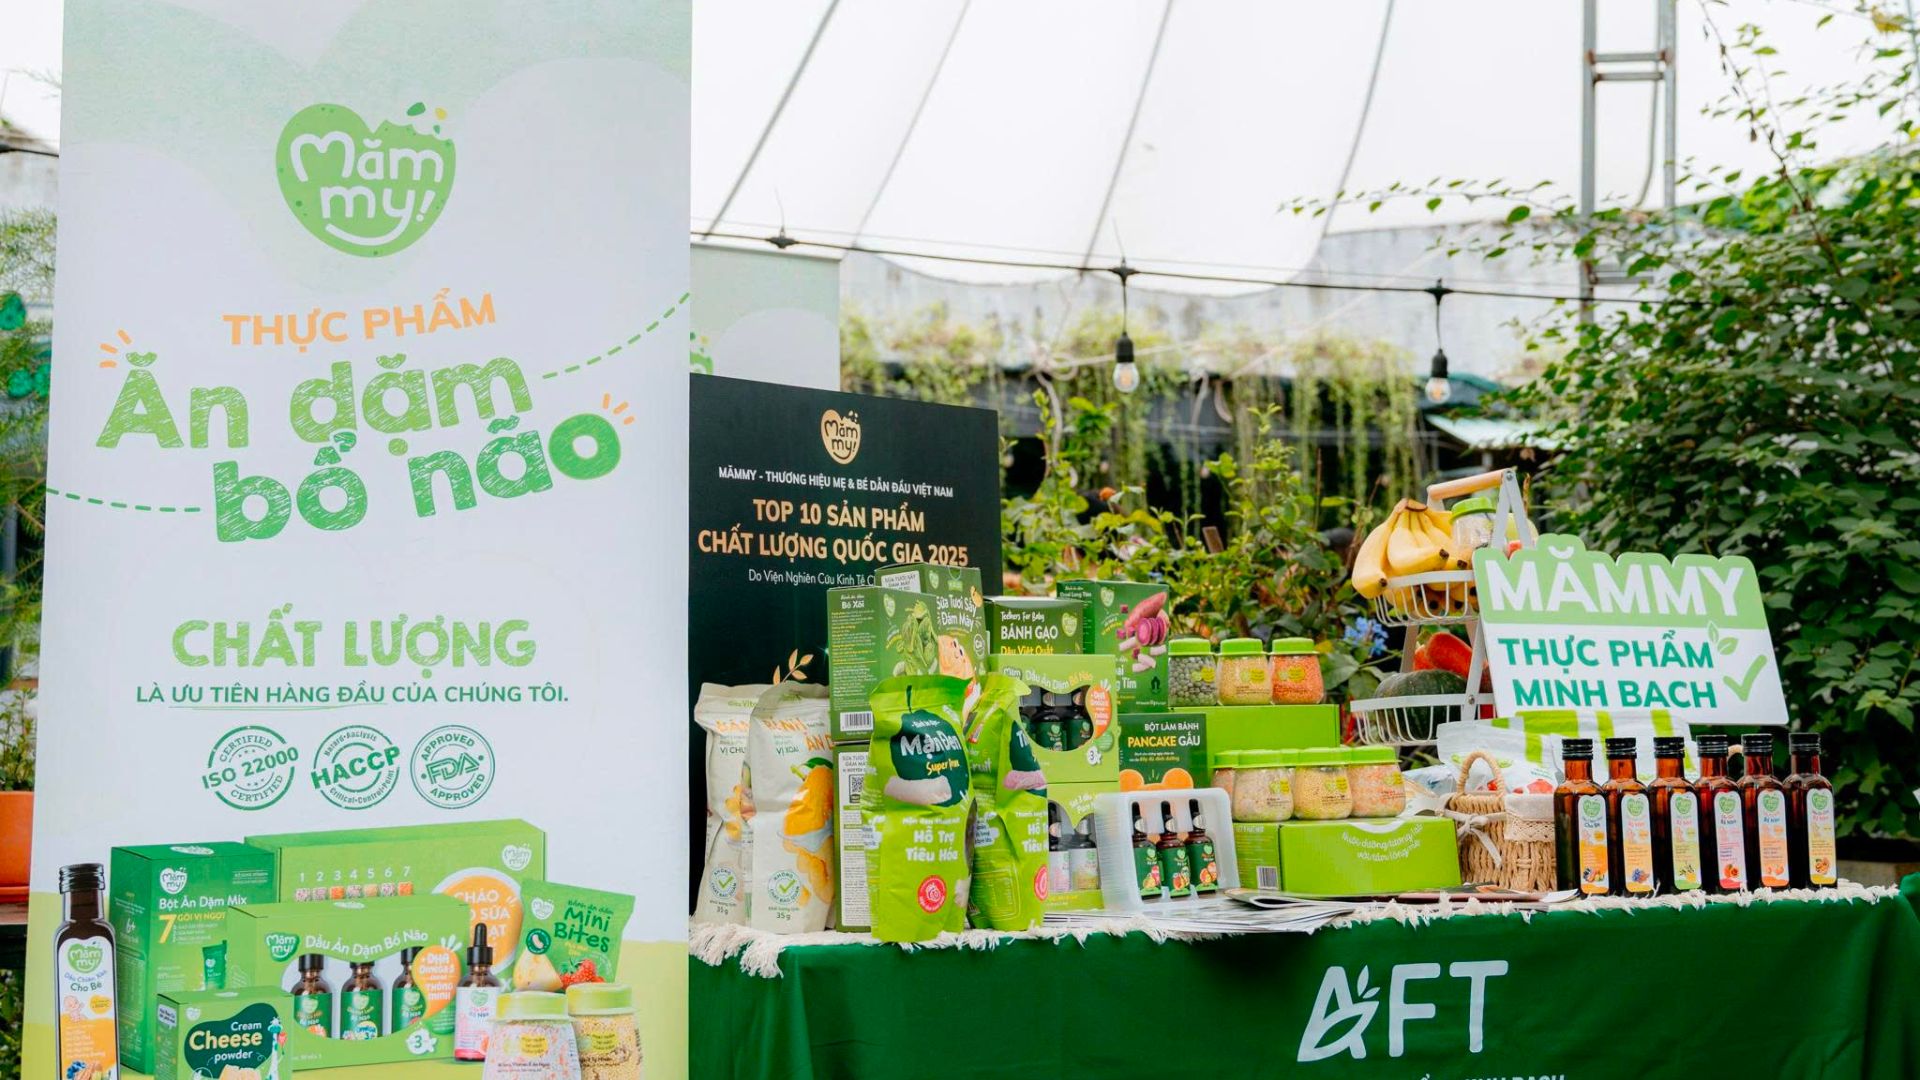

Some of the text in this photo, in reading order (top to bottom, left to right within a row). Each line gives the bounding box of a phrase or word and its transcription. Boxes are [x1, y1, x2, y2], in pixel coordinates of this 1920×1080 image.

[290, 131, 444, 182] Măm
[320, 186, 436, 246] my!
[223, 288, 496, 351] THỰC PHẨM
[96, 351, 533, 456] Ăn dặm
[824, 420, 858, 439] Măm
[831, 438, 857, 460] my!
[213, 412, 621, 542] bổ não
[765, 470, 807, 485] THƯƠNG
[808, 472, 831, 488] HIỆU
[832, 477, 846, 491] MẸ
[847, 478, 855, 488] &
[856, 476, 869, 490] BÉ
[912, 482, 932, 498] VIỆT
[933, 486, 954, 497] NAM
[753, 498, 925, 533] TOP 10 SẢN PHẨM
[697, 523, 969, 566] CHẤT LƯỢNG QUỐC GIA 2025
[748, 569, 762, 581] Do
[764, 570, 784, 584] Viện
[786, 572, 815, 585] Nghiên
[817, 573, 835, 585] Cứu
[837, 574, 855, 585] Kinh
[1485, 546, 1743, 617] MĂMMY
[172, 602, 537, 679] CHẤT LƯỢNG
[1001, 623, 1059, 643] BÁNH GẠO
[1498, 630, 1714, 674] THỰC PHẨM
[136, 678, 569, 703] LÀ ƯU TIÊN HÀNG ĐẦU CỦA CHÚNG TÔI.
[1123, 677, 1137, 689] Tím
[1512, 679, 1608, 707] MINH
[1128, 731, 1200, 748] PANCAKE GẤU
[1144, 722, 1199, 733] BỘT LÀM BÁNH
[219, 735, 273, 763] CERTIFIED
[421, 733, 475, 761] APPROVED
[202, 746, 299, 789] ISO 22000
[311, 746, 400, 790] HACCP
[426, 752, 480, 784] FDA
[926, 761, 948, 776] Super
[231, 775, 283, 802] CERTIFIED
[430, 774, 485, 801] APPROVED
[914, 825, 955, 845] Hỗ Trợ
[906, 847, 935, 862] Tiêu
[316, 872, 324, 881] 2
[334, 870, 341, 880] 3
[350, 870, 358, 879] 4
[367, 868, 375, 879] 5
[384, 867, 393, 878] 6
[403, 865, 411, 877] 7
[159, 893, 247, 911] Bột Ăn Dặm Mix
[159, 914, 177, 944] 7
[564, 906, 611, 932] Mini
[305, 929, 428, 959] Dầu Ăn Dặm Bổ Não
[554, 921, 610, 953] Bites
[70, 980, 103, 992] Cho Bé
[1297, 960, 1509, 1062] AFT
[230, 1021, 262, 1032] Cream
[189, 1030, 263, 1051] Cheese
[413, 1035, 423, 1048] 3
[214, 1049, 253, 1065] powder
